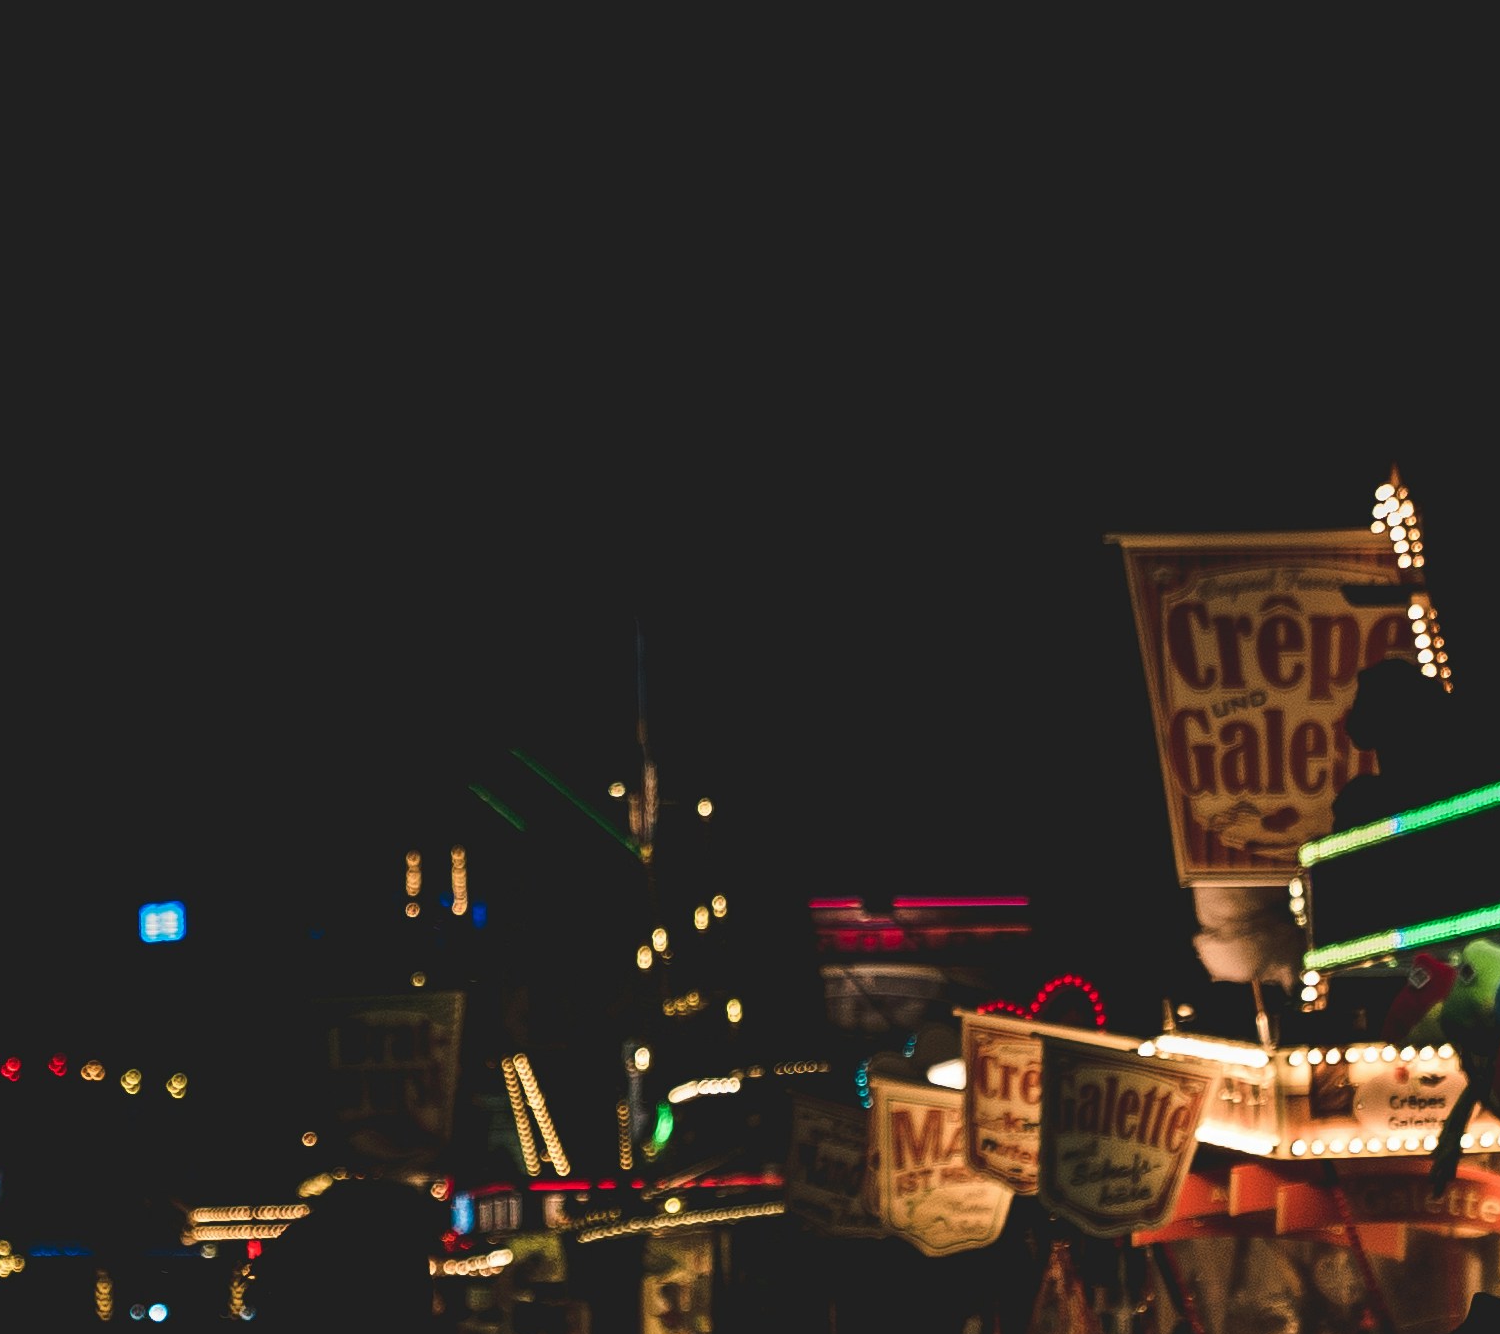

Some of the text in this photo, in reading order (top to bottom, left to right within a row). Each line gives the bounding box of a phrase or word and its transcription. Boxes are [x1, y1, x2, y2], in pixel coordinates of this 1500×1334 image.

[979, 1054, 1043, 1105] Crê
[1388, 1094, 1446, 1111] Crêpes
[1055, 1074, 1193, 1154] Galette
